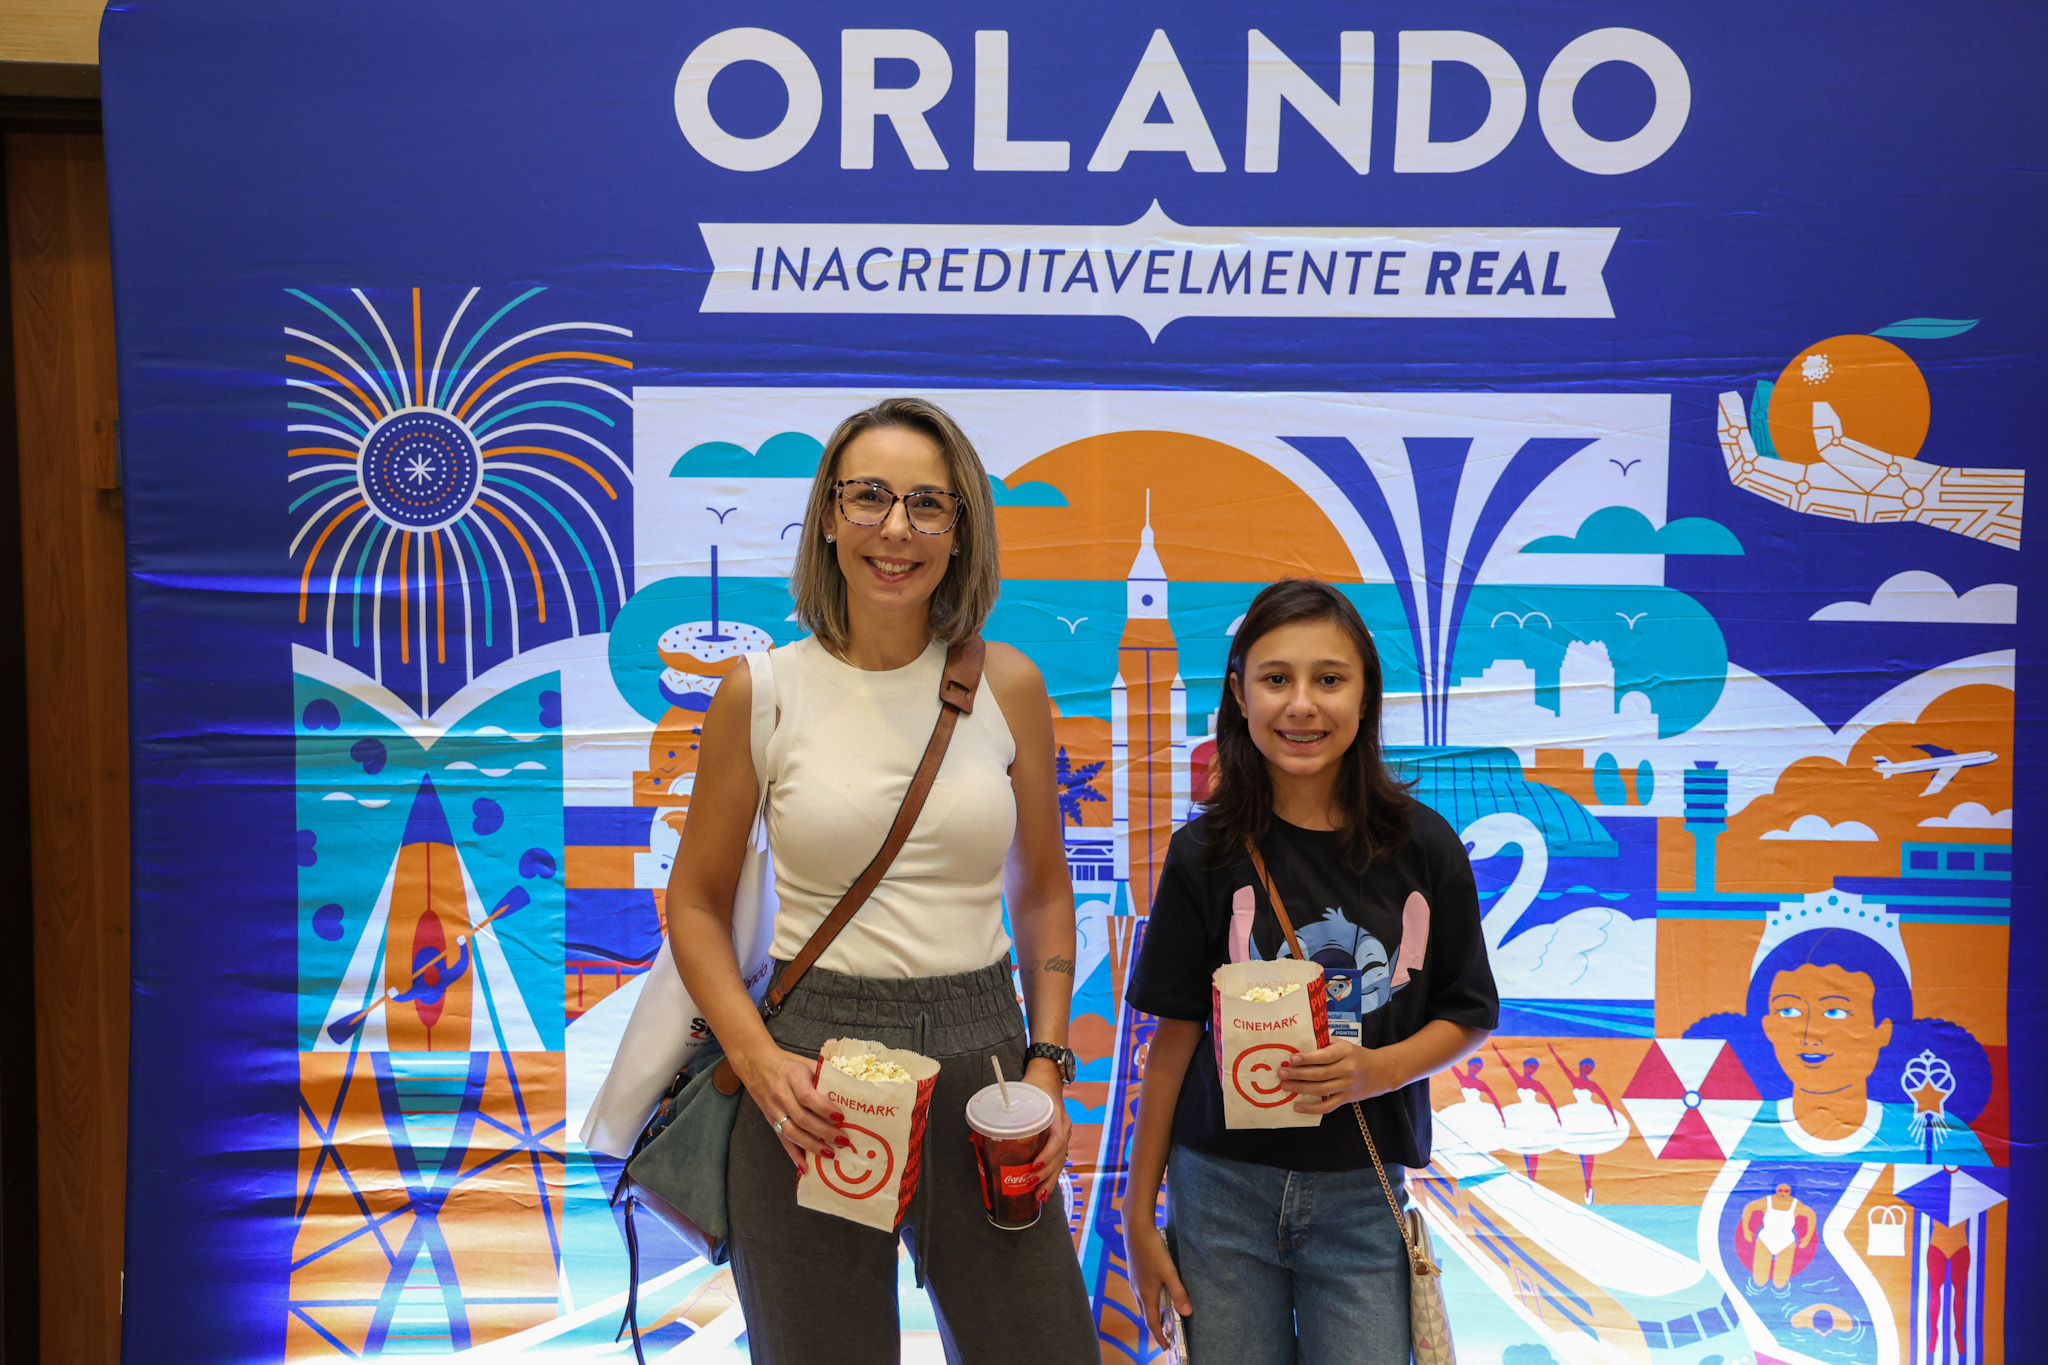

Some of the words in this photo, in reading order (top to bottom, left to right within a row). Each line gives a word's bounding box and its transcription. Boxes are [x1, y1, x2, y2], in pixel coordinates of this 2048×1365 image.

[673, 27, 1692, 175] ORLANDO
[750, 245, 1406, 296] INACREDITAVELMENTE
[1425, 251, 1568, 296] REAL
[1233, 1014, 1298, 1031] CINEMARK
[827, 1090, 896, 1117] CINEMARK
